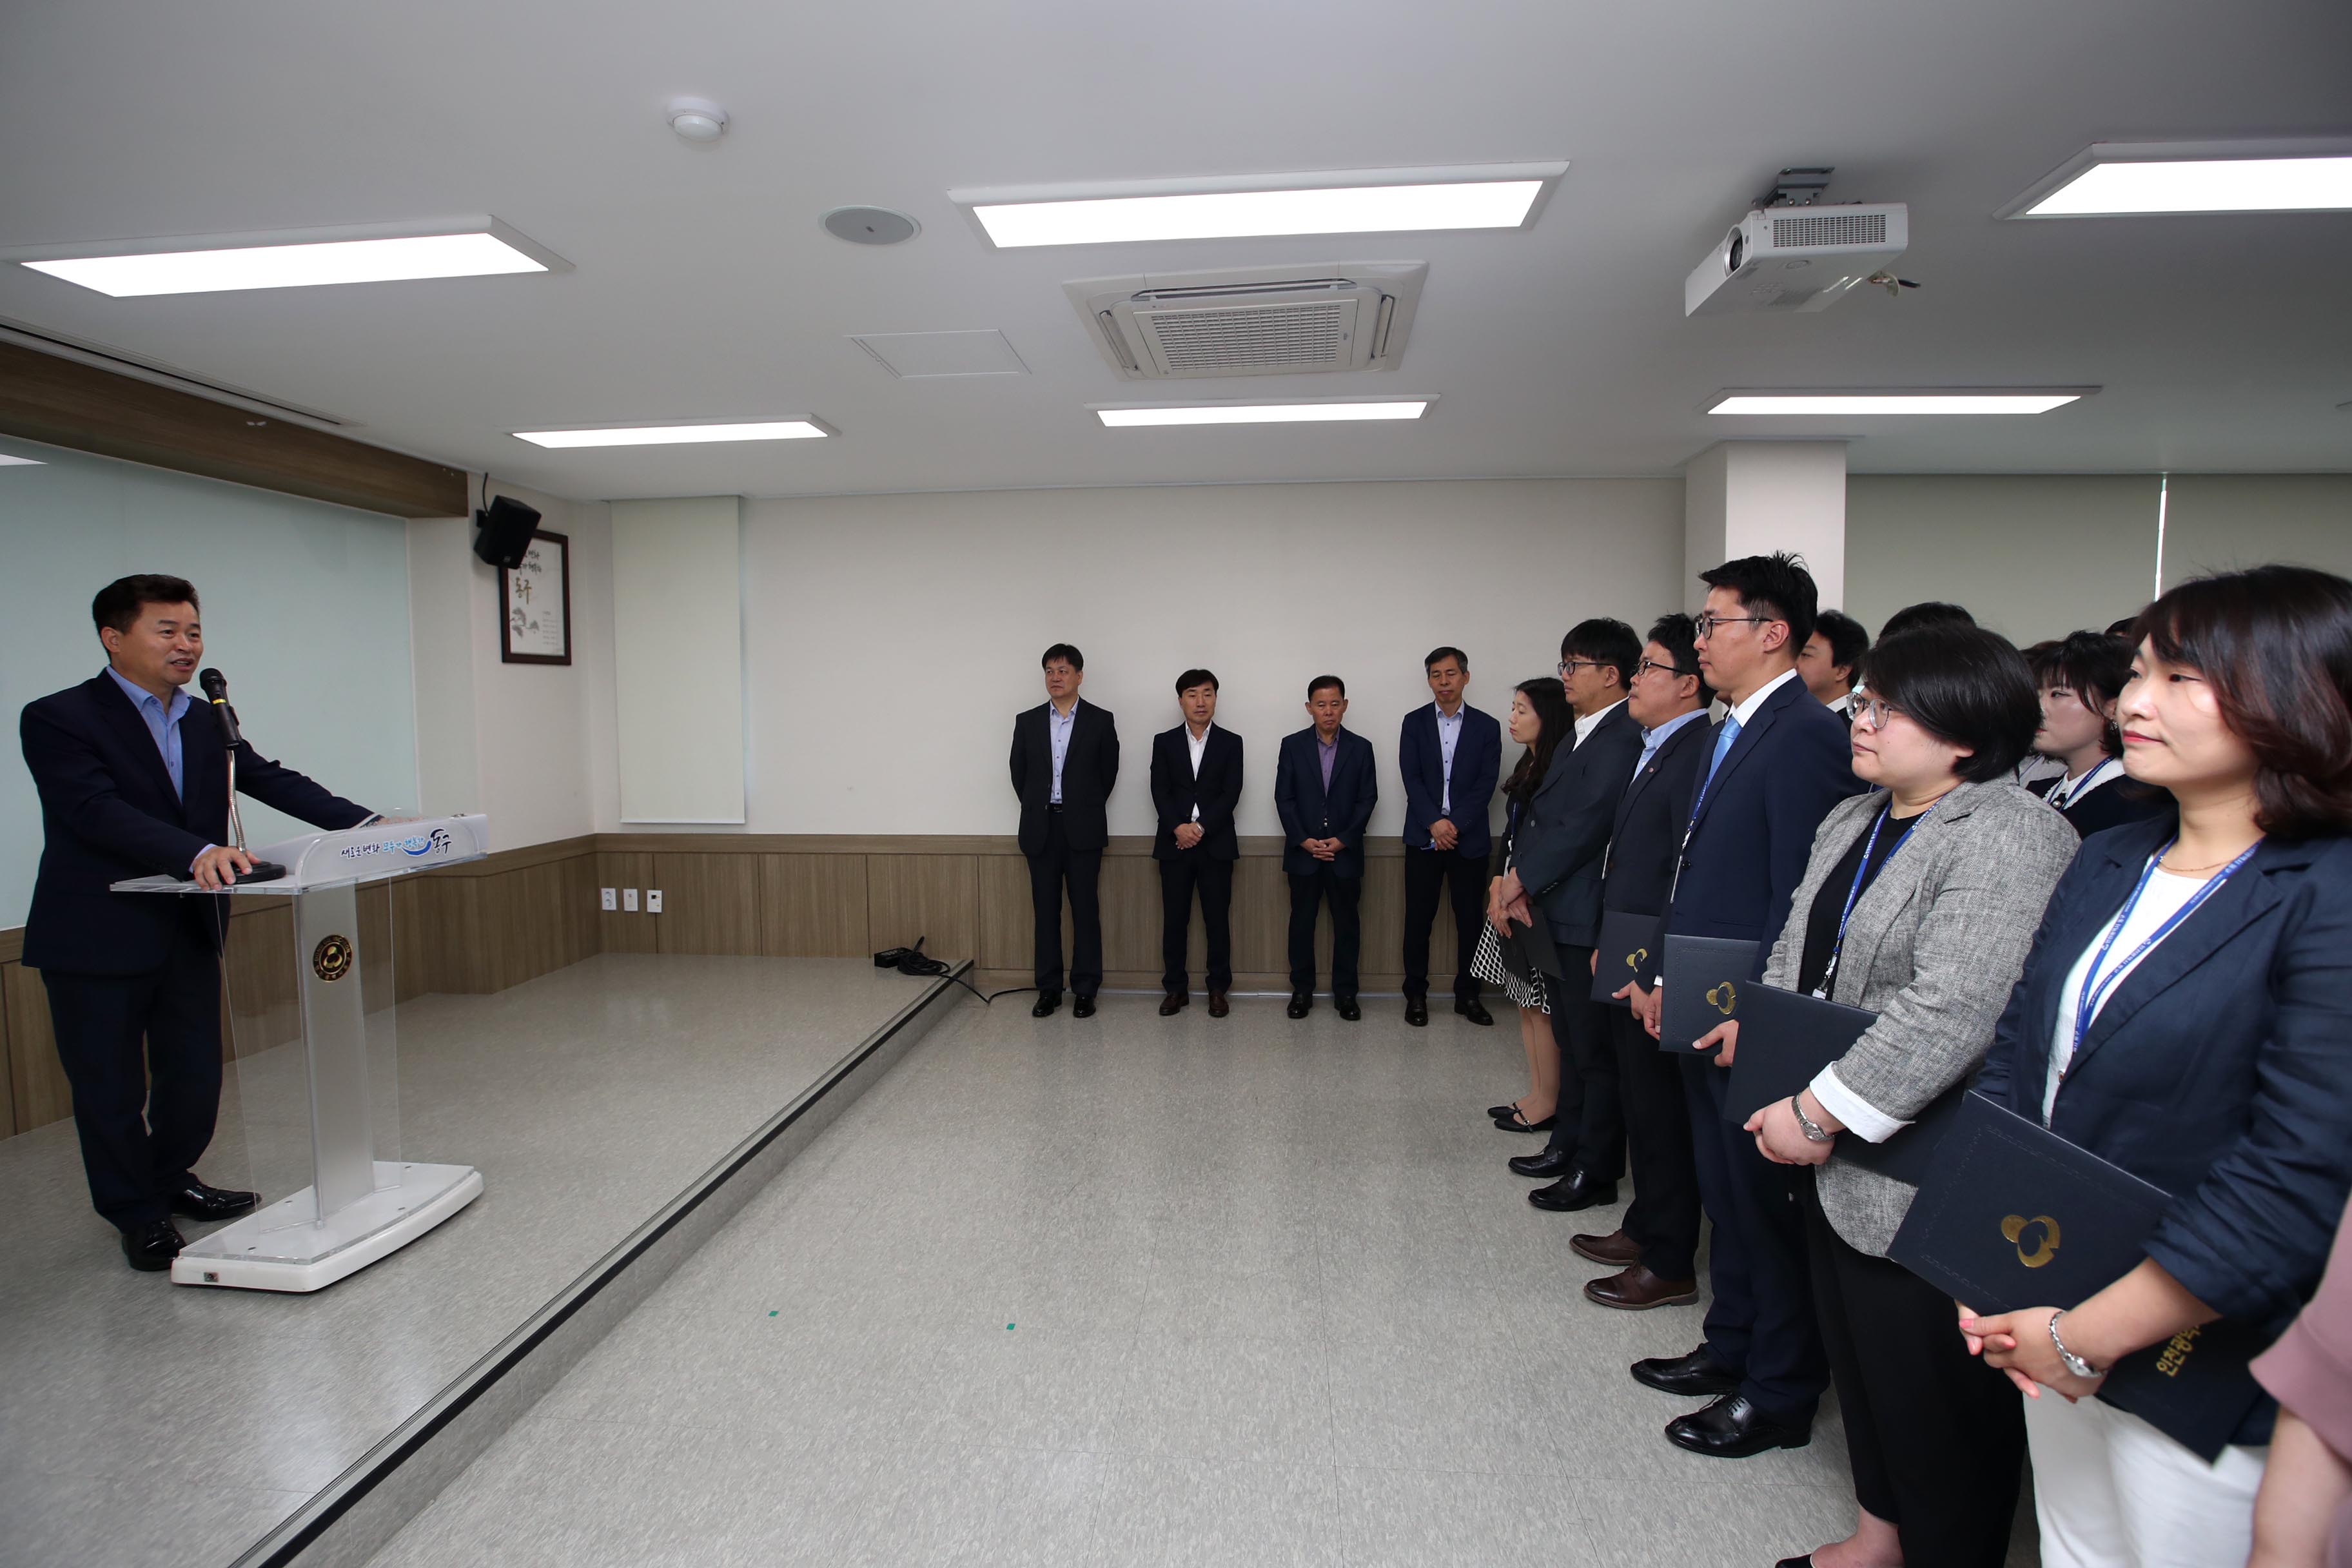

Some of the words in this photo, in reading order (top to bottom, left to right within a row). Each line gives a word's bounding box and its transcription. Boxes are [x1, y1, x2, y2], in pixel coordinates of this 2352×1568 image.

[341, 847, 362, 858] 새로운
[362, 843, 380, 855] 변화
[383, 840, 402, 853] 모두가
[430, 828, 451, 854] 동구
